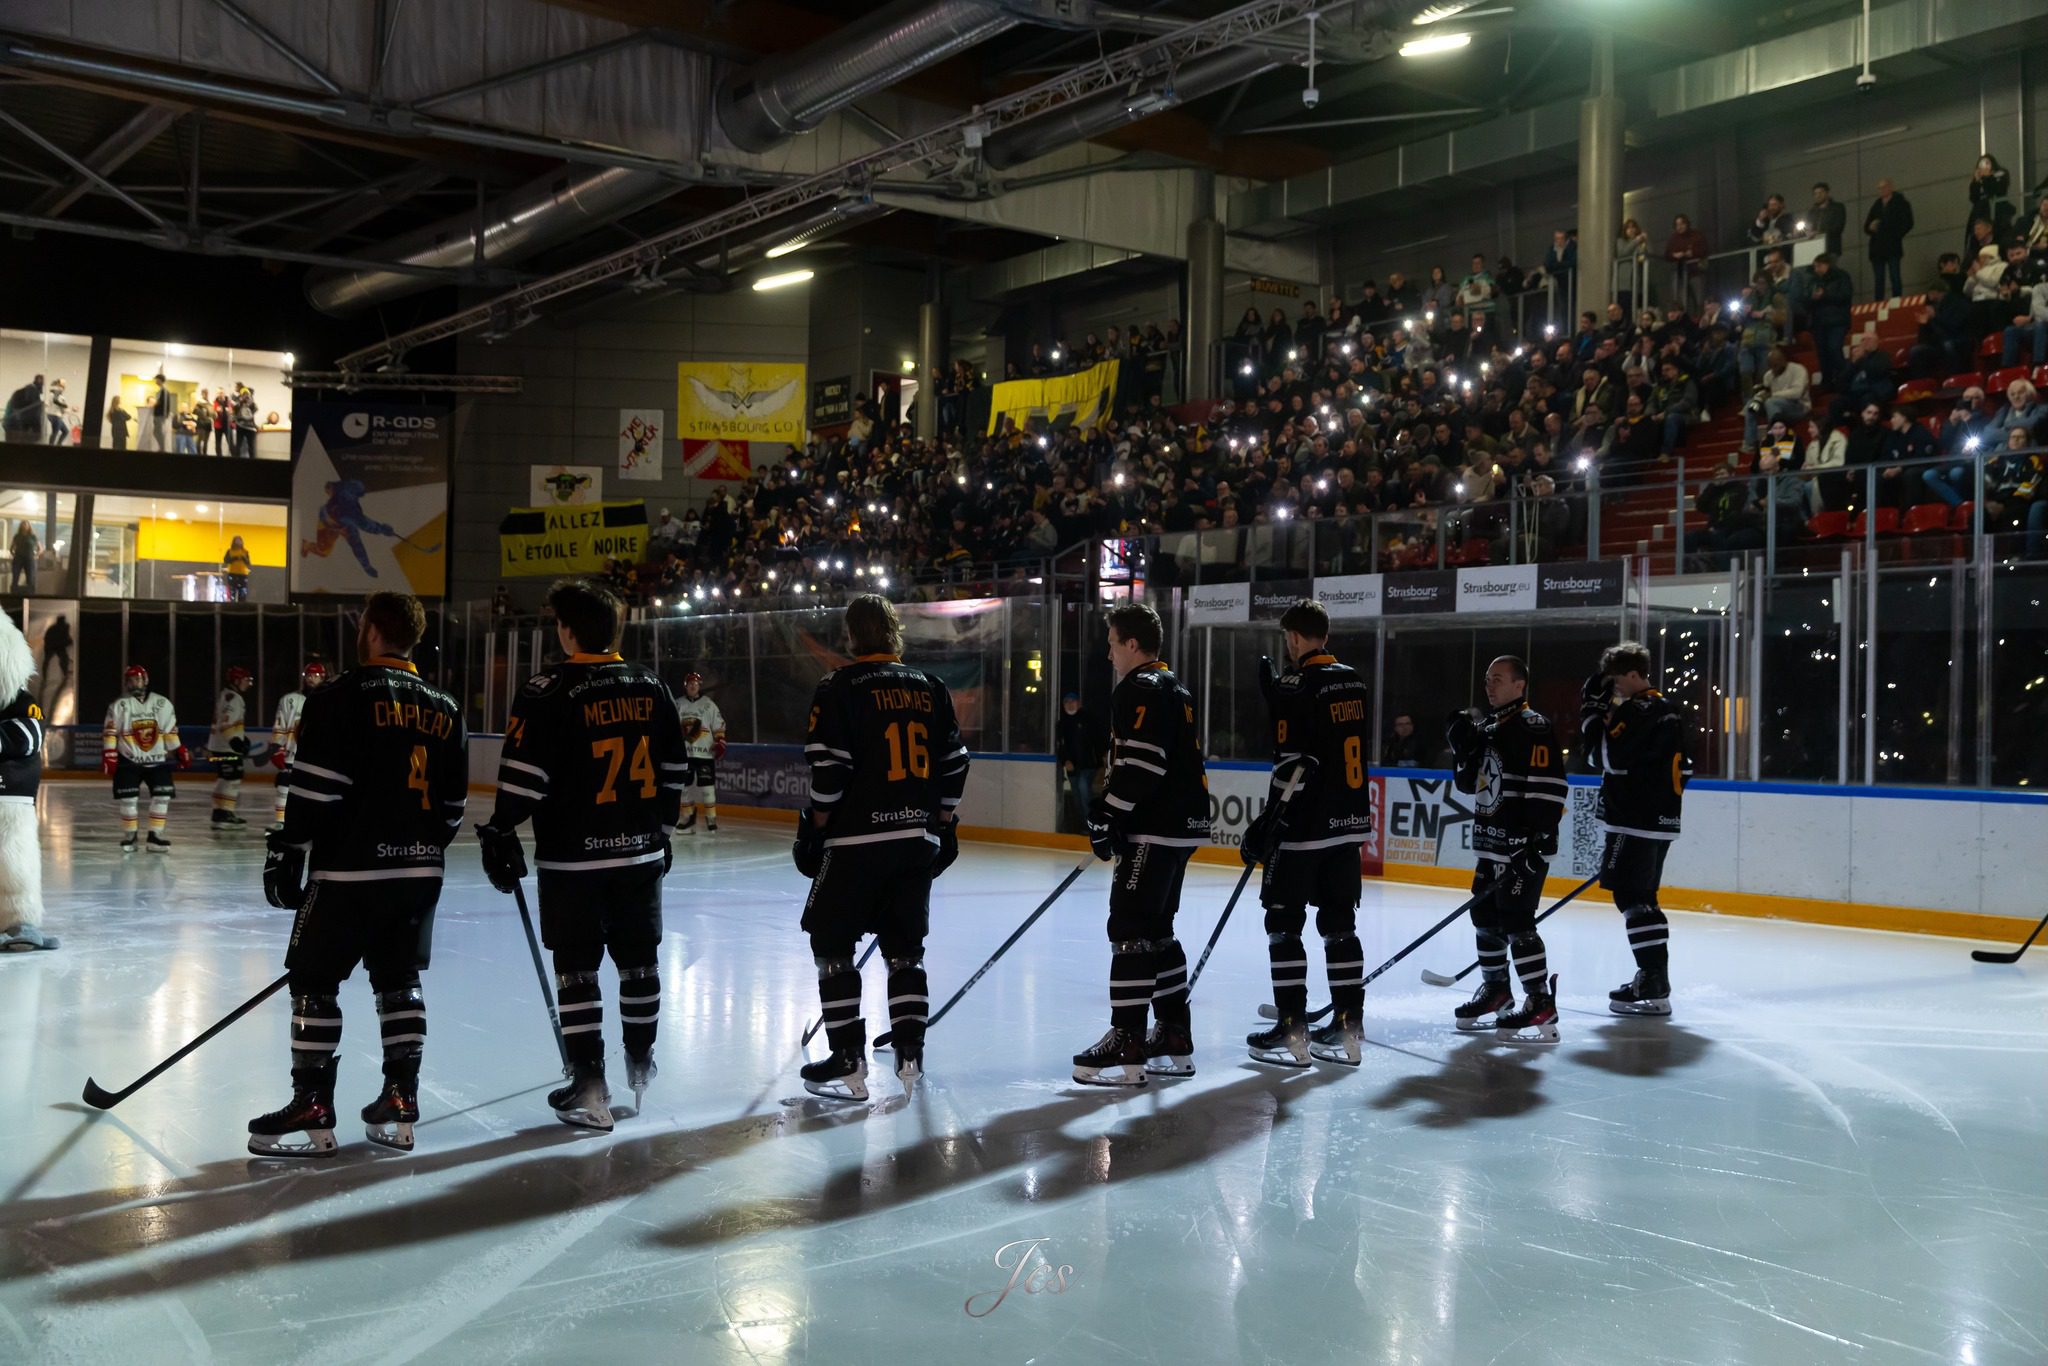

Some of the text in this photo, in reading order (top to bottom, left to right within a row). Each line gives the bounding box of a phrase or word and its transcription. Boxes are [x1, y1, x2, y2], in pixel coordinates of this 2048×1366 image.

[373, 415, 436, 430] R-GDS
[549, 511, 600, 529] ALLEZ
[1318, 589, 1377, 603] Strasbourg.eu
[1463, 581, 1531, 596] Strasbourg.eu
[870, 688, 933, 714] THOMAS
[1330, 699, 1364, 724] POIROT
[1275, 719, 1289, 746] 8
[883, 719, 930, 783] 16
[1343, 734, 1366, 791] 8
[1529, 743, 1550, 769] 10
[408, 743, 433, 813] 4
[591, 735, 658, 807] 74
[715, 767, 770, 793] rand Est
[773, 769, 810, 795] Gran
[1390, 801, 1441, 838] EN
[1388, 838, 1420, 850] FONDS
